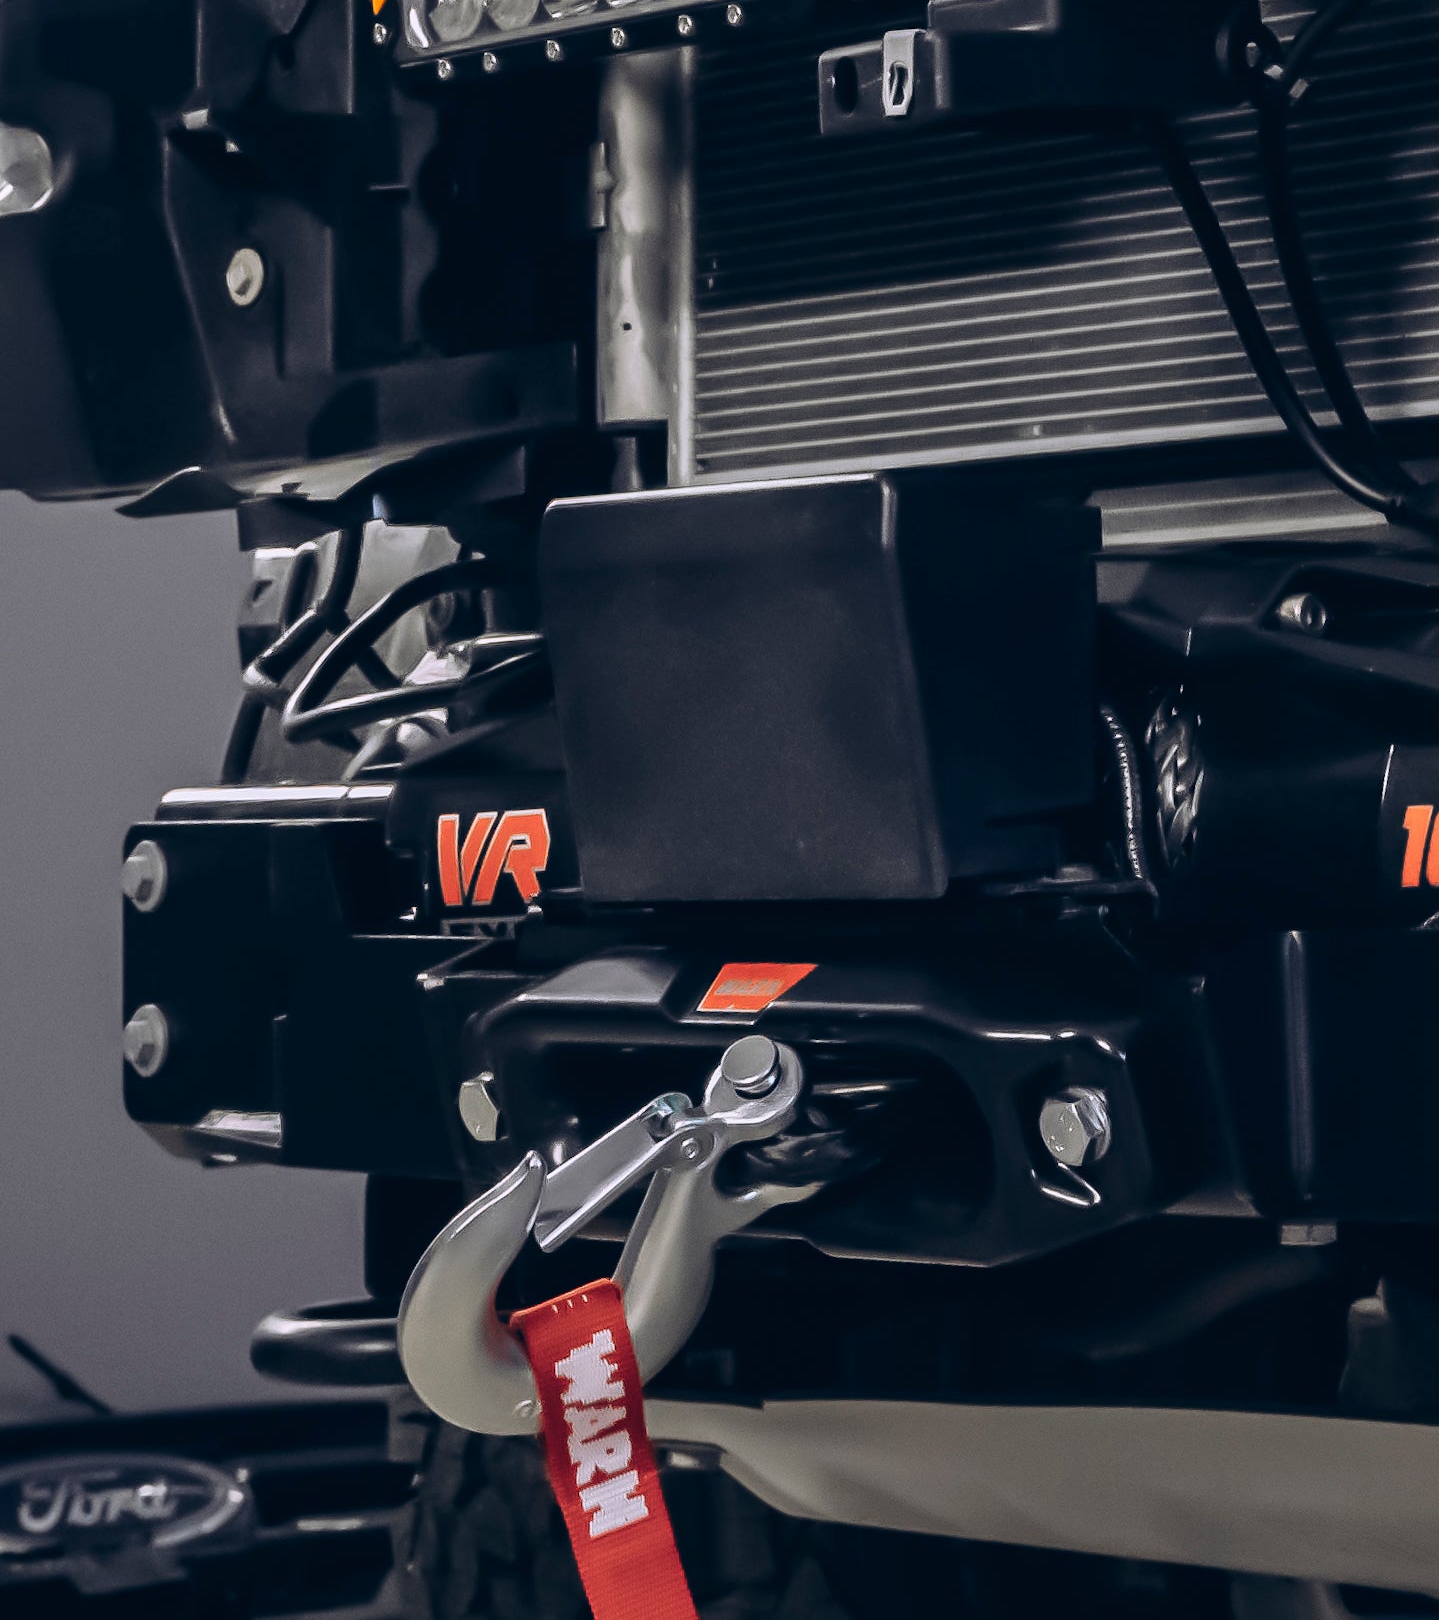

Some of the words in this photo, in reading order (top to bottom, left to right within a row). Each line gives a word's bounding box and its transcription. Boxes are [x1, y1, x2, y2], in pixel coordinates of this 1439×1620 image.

[437, 808, 551, 906] VR
[555, 1329, 649, 1539] WARN
[17, 1473, 185, 1533] Ford
